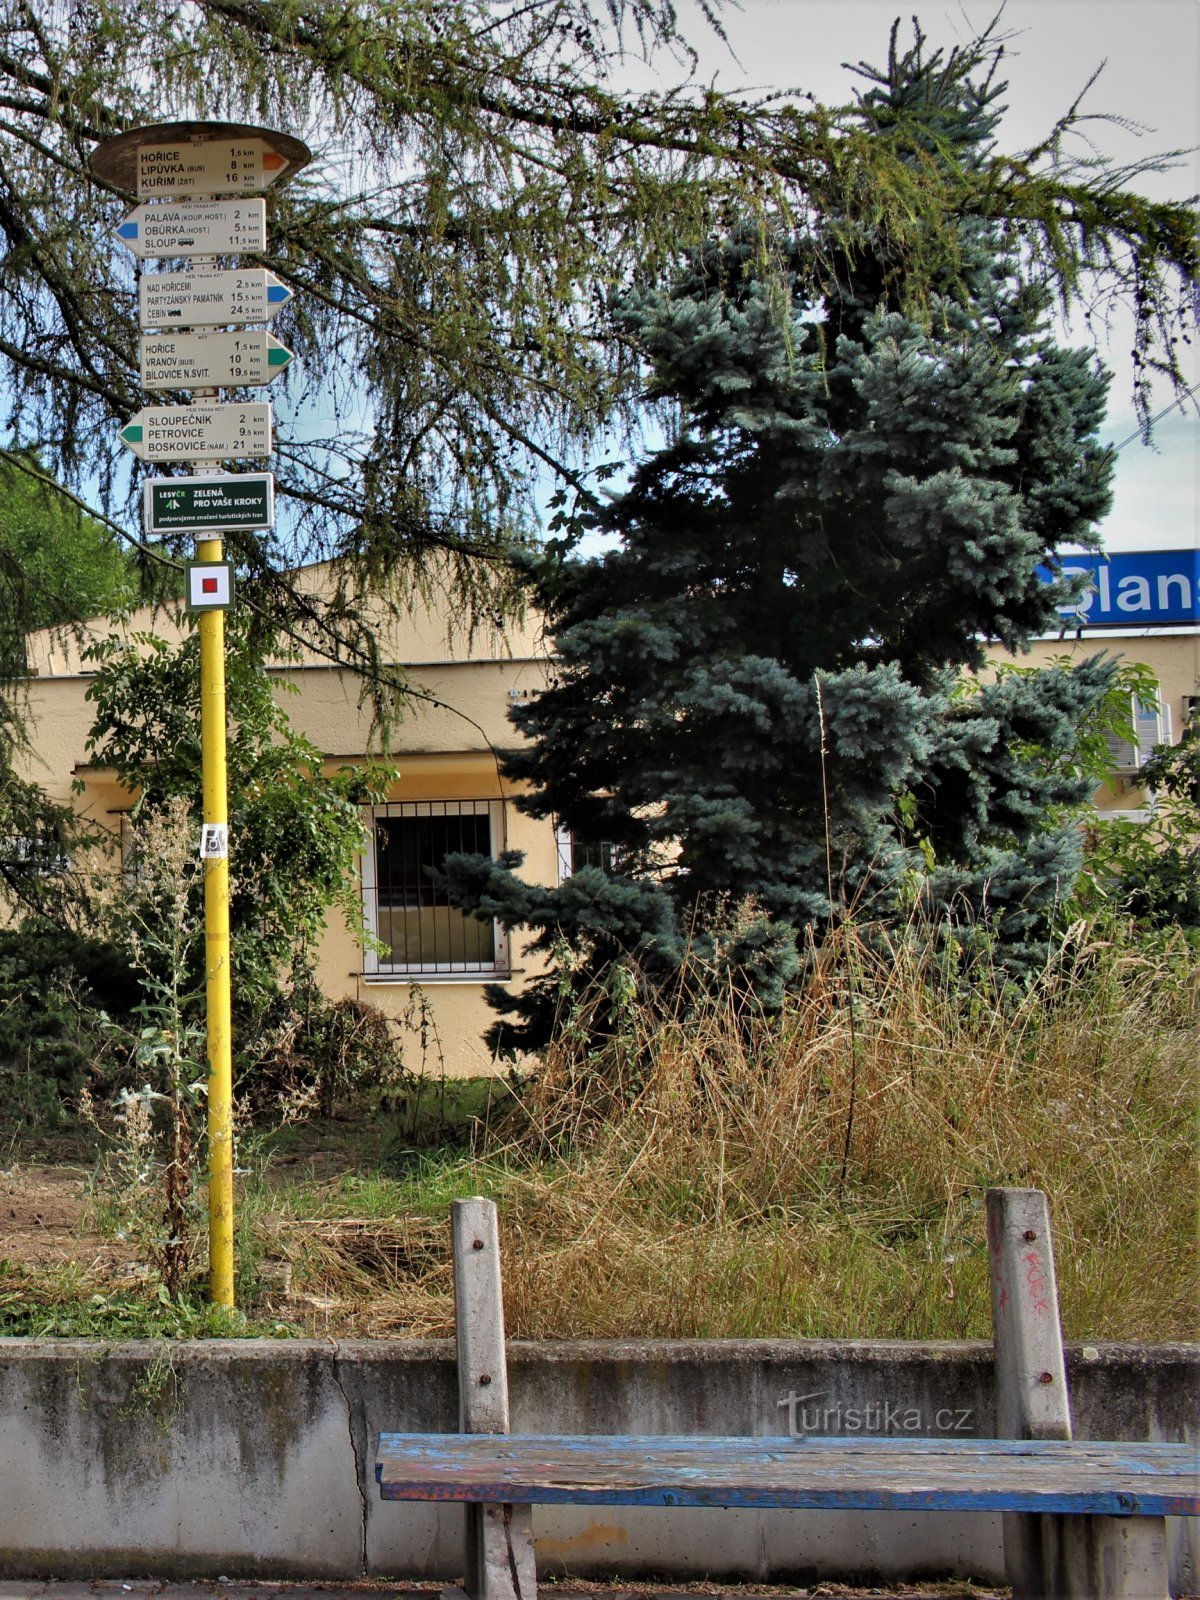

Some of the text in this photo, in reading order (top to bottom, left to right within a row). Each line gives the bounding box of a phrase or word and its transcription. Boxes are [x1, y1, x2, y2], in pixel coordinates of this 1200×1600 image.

[141, 151, 180, 163] HOŘICE
[141, 163, 184, 176] LIPŮVKA
[187, 165, 205, 174] (BUS)
[230, 160, 237, 170] 8
[141, 176, 175, 188] KUŘIM
[225, 174, 238, 182] 16
[144, 213, 180, 222] PALAVA
[234, 210, 240, 220] 2
[144, 224, 186, 236] OBŮRKA
[144, 238, 176, 248] SLOUP
[146, 284, 160, 292] NAD
[162, 282, 192, 292] HOŘICEMI
[146, 294, 192, 306] PARTYZÁNSKÝ
[192, 292, 224, 303] PAMÁTNÍK
[146, 308, 166, 318] ČEBÍN
[146, 342, 176, 354] HOŘICE
[146, 356, 178, 366] VRANOV
[178, 358, 196, 366] (BUS)
[229, 354, 241, 364] 10
[146, 369, 182, 380] BÍLOVICE
[148, 414, 212, 426] SLOUPEČNÍK
[240, 414, 246, 424] 2
[148, 428, 204, 438] PETROVICE
[148, 441, 206, 452] BOSKOVICE
[207, 442, 229, 451] (NÁM.)
[233, 440, 245, 450] 21
[194, 488, 224, 498] ZELENÁ
[194, 497, 263, 508] PRO VAŠE KROKY
[158, 514, 196, 523] podporujeme
[218, 512, 252, 520] turistických
